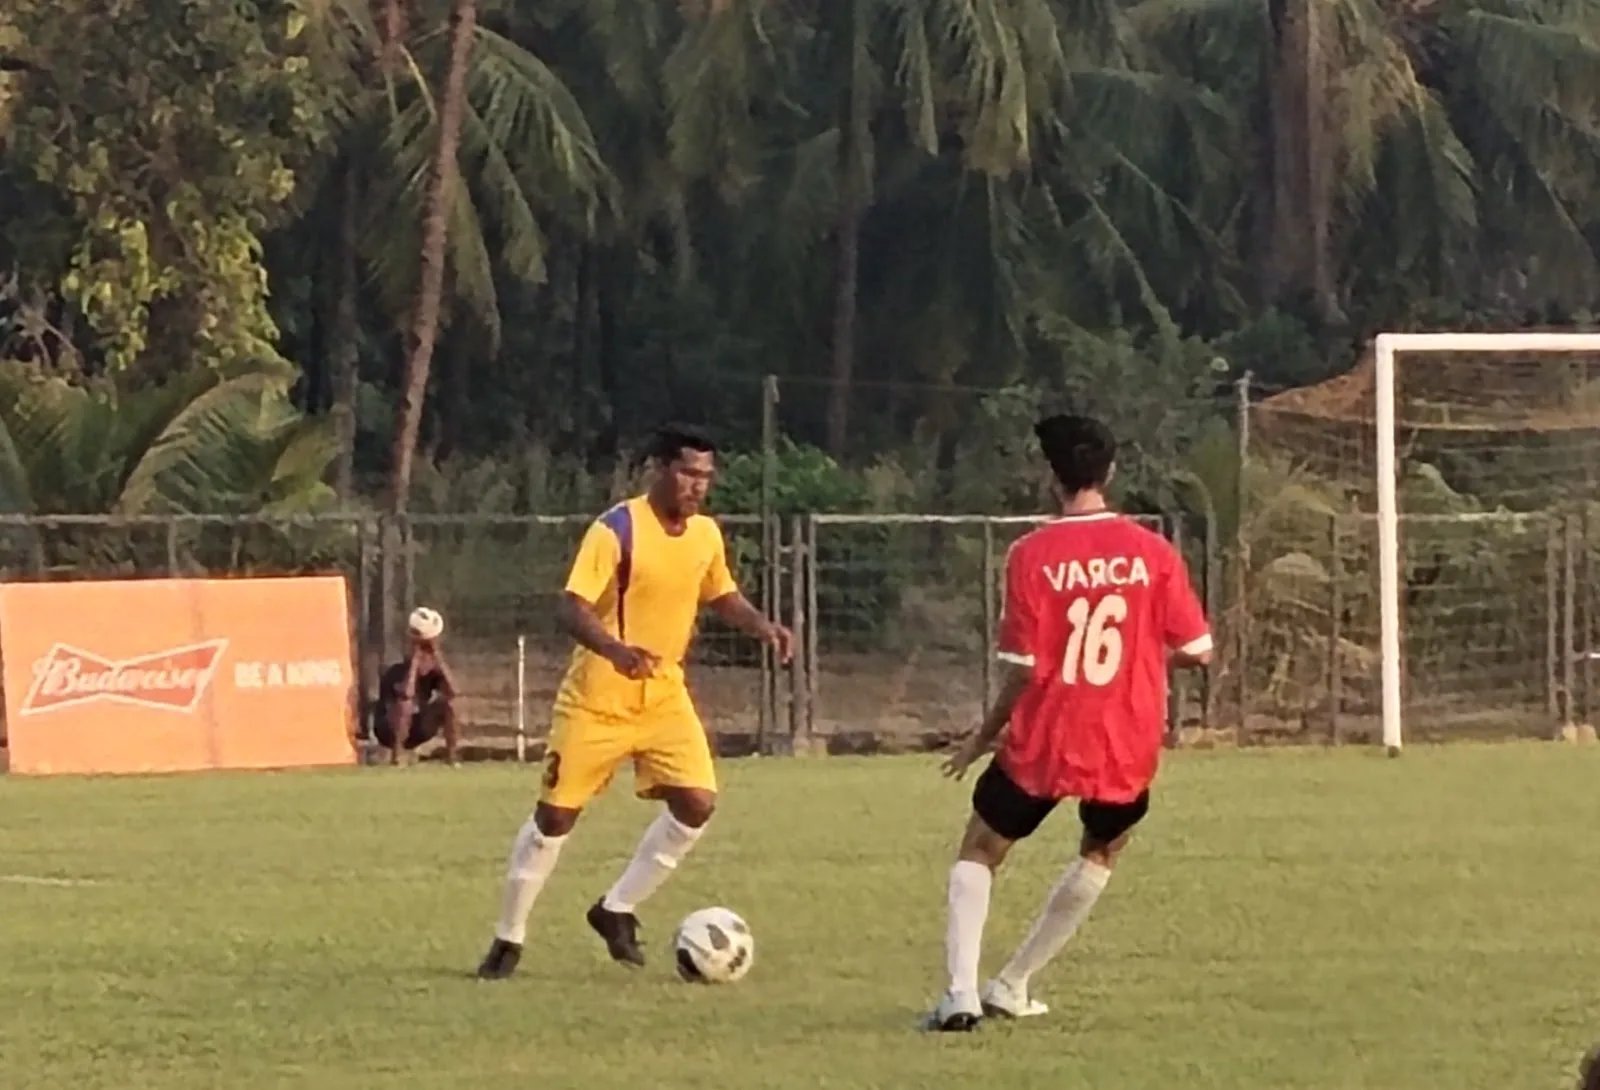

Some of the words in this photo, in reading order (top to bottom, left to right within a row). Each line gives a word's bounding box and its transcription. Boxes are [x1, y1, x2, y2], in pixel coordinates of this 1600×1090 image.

[1043, 556, 1149, 592] VARCA
[1062, 594, 1127, 686] 16
[32, 657, 213, 697] Budweiser
[267, 662, 283, 686] A
